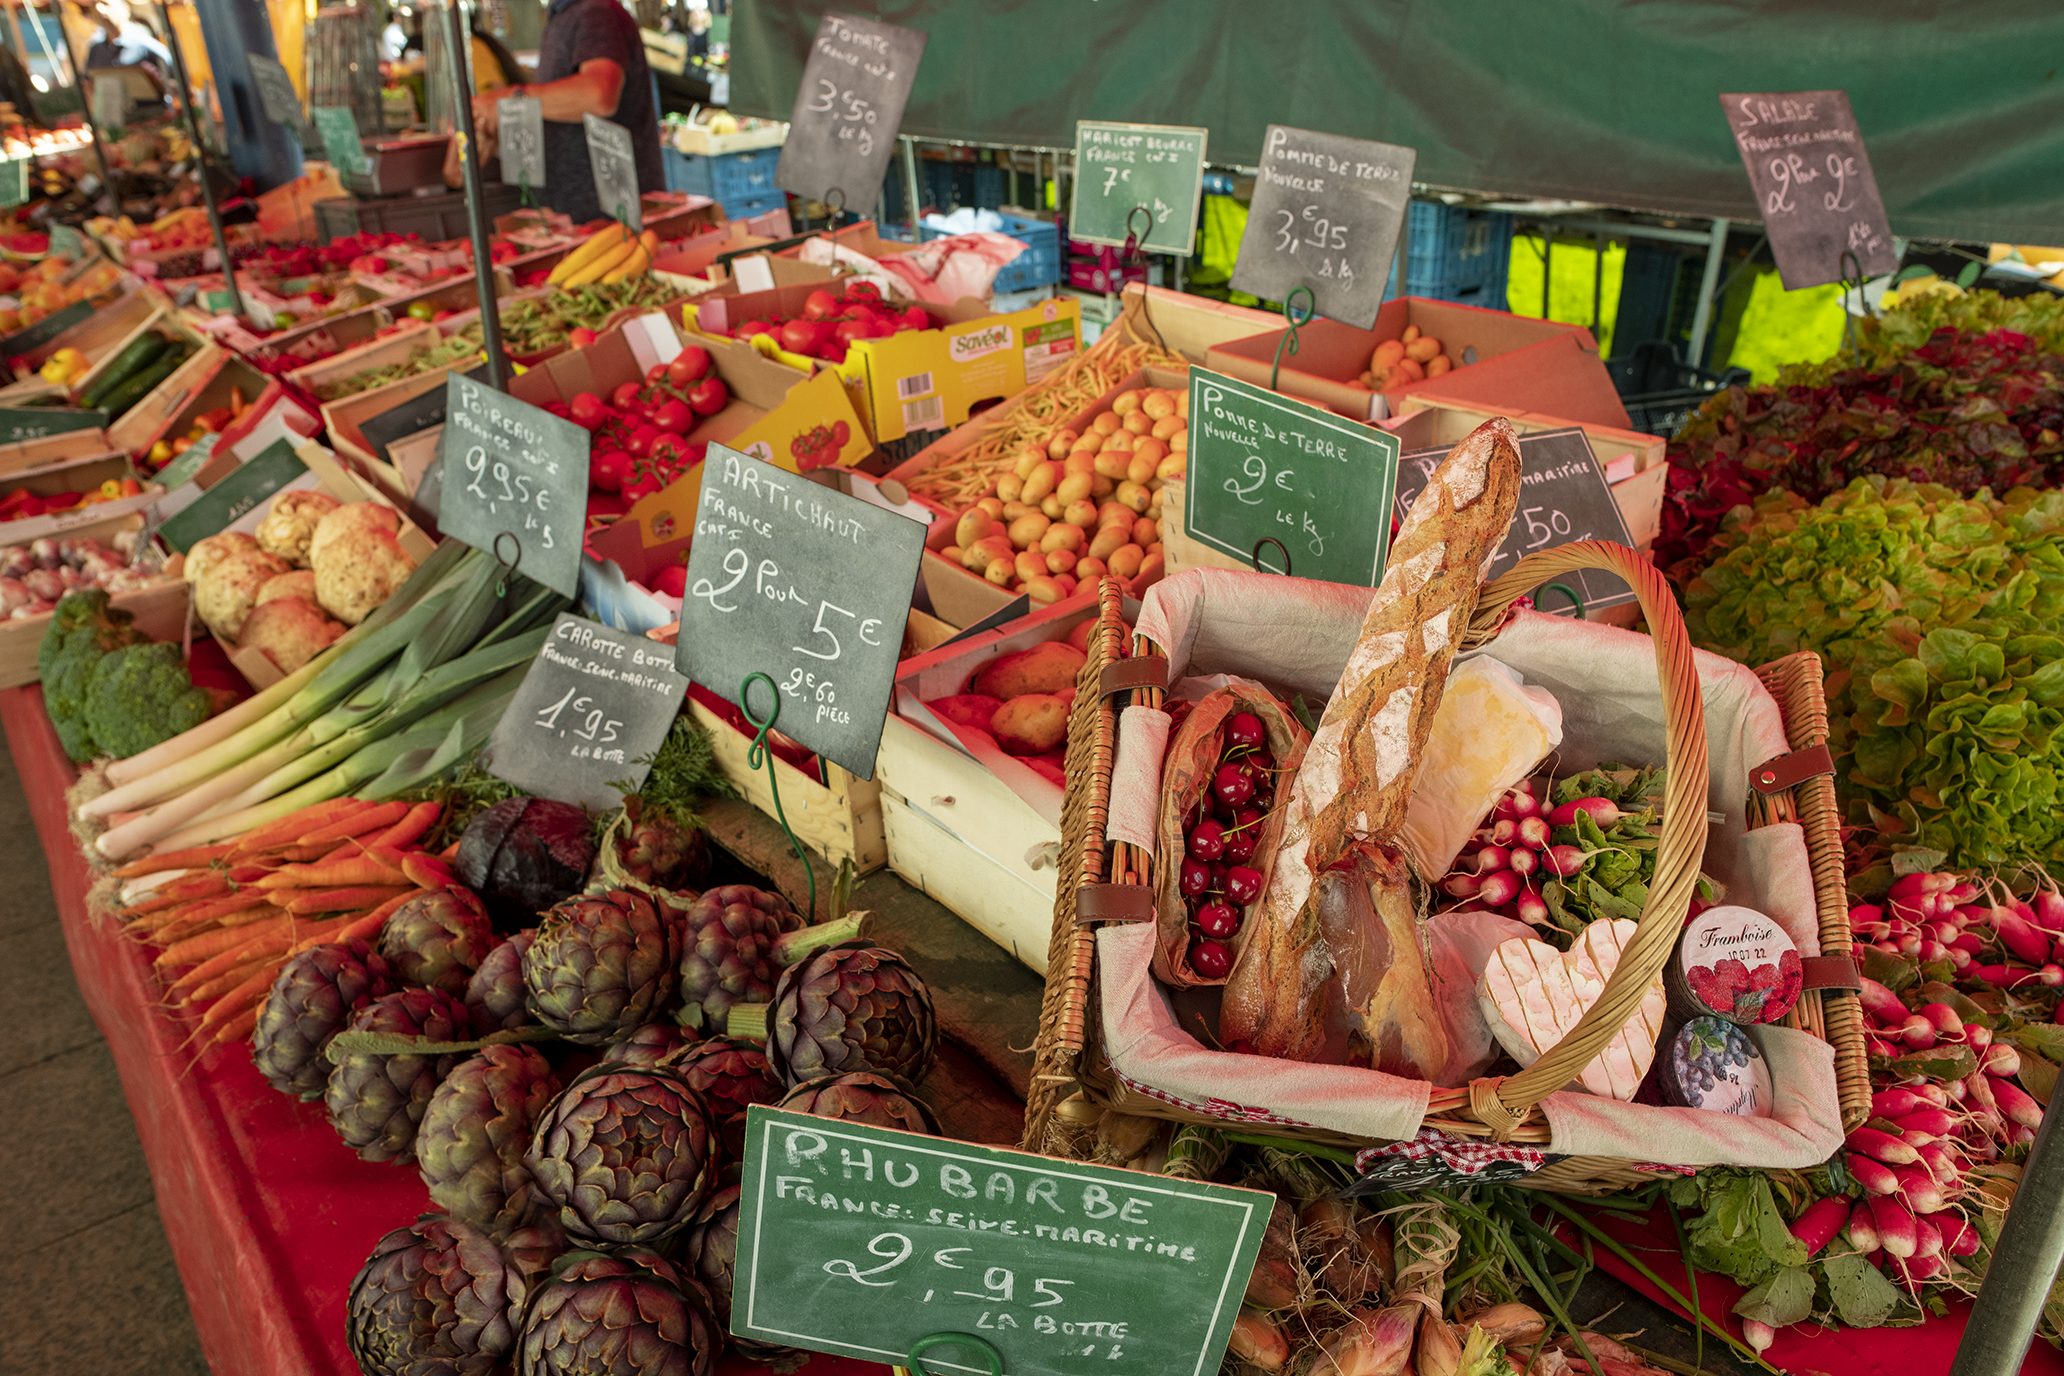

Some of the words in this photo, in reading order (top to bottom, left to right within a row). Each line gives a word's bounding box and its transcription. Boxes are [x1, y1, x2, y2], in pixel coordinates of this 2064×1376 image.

[1739, 97, 1819, 127] SALADE
[1086, 145, 1136, 163] FRANCE
[1327, 155, 1351, 176] DE
[1767, 158, 1797, 215] 2
[955, 325, 1009, 353] Savéol
[453, 411, 511, 451] FRANCE
[1203, 420, 1260, 450] NOUVELLE
[1262, 422, 1289, 445] DE
[1290, 431, 1348, 462] TERRE
[703, 487, 773, 538] FRANCE
[692, 548, 749, 613] 2
[556, 621, 626, 659] CAROTTE
[632, 648, 677, 673] BOTTE
[570, 744, 591, 758] LA
[592, 746, 626, 765] BOTTE
[1700, 924, 1773, 948] Framboise
[785, 1130, 1153, 1225] RHUBARBE
[976, 1311, 1020, 1331] LA
[1034, 1315, 1129, 1340] BOTTE
